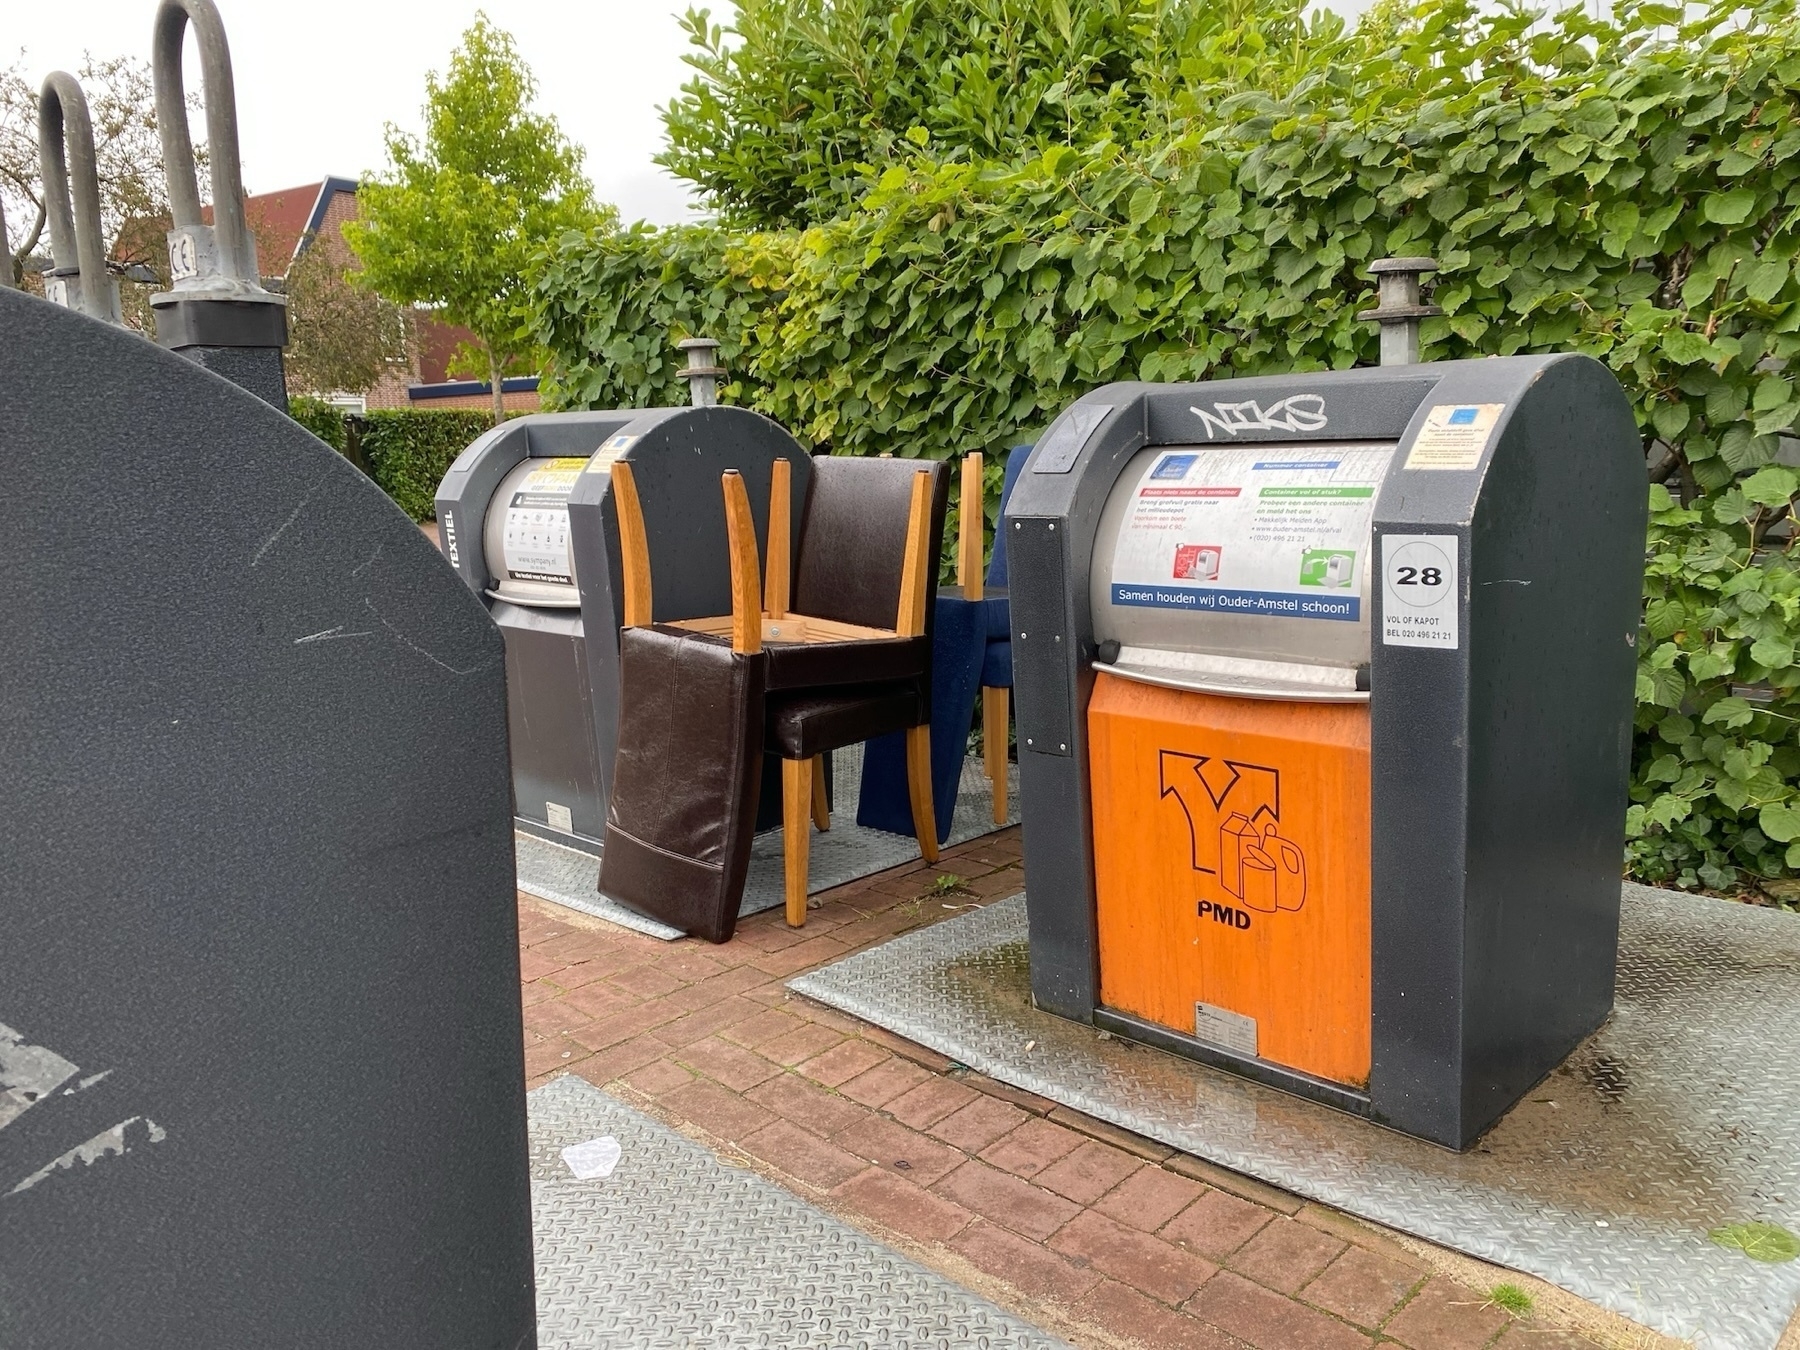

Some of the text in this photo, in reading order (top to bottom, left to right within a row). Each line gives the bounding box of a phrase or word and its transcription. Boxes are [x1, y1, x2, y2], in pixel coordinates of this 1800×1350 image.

[1313, 517, 1328, 525] App
[1255, 526, 1343, 534] www.ouder-amstel.nl/afval
[1253, 535, 1272, 543] (020)
[1396, 566, 1442, 586] 28
[1119, 589, 1350, 615] Samen houden wij Ouder-Amstel schoon!
[1386, 615, 1439, 625] VOL OF KAPOT
[1386, 628, 1451, 640] BEL 020 496 21 21
[1197, 899, 1251, 931] PMD
